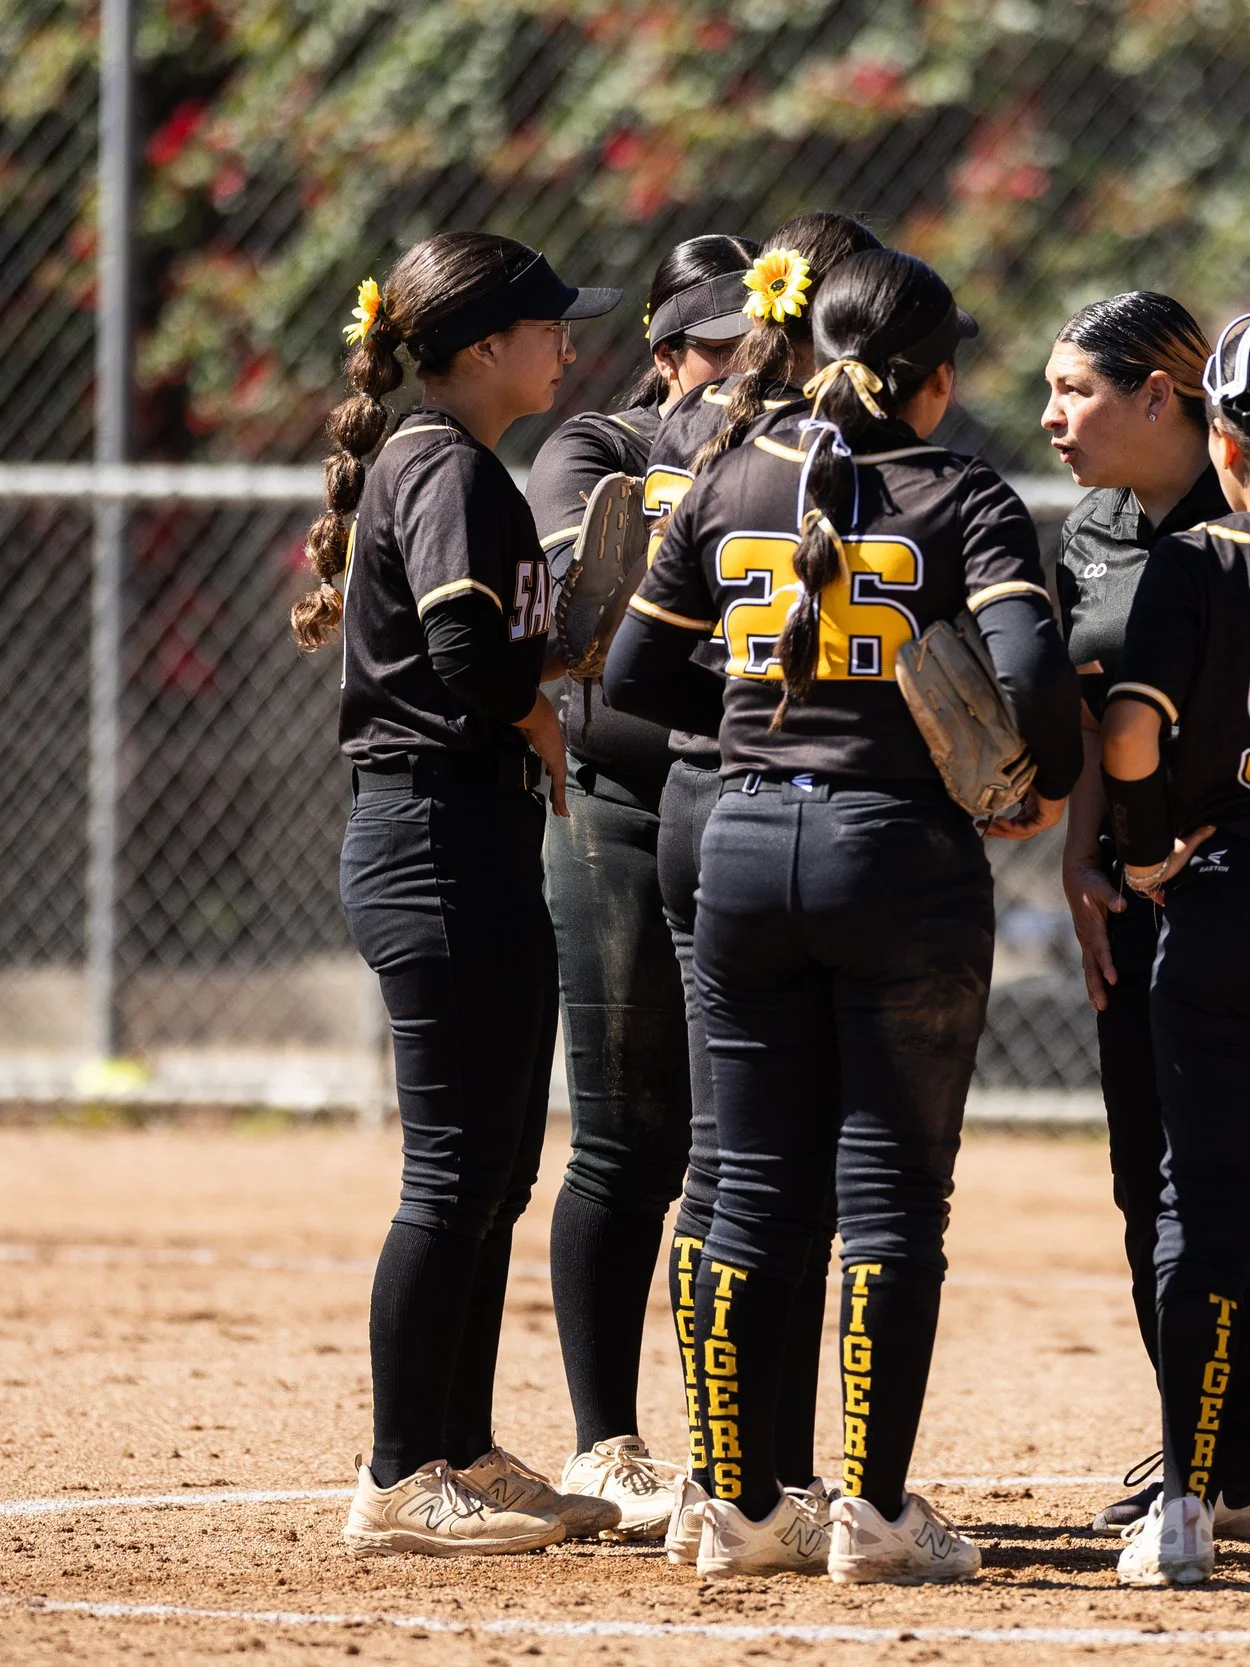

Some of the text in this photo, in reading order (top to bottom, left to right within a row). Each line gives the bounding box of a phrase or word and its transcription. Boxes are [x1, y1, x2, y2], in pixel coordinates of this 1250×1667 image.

[509, 561, 552, 642] SA
[716, 530, 923, 681] 26
[1198, 865, 1230, 873] EASTON
[704, 1261, 748, 1499] TIGERS
[842, 1263, 882, 1497] TIGERS
[1187, 1292, 1237, 1500] TIGERS
